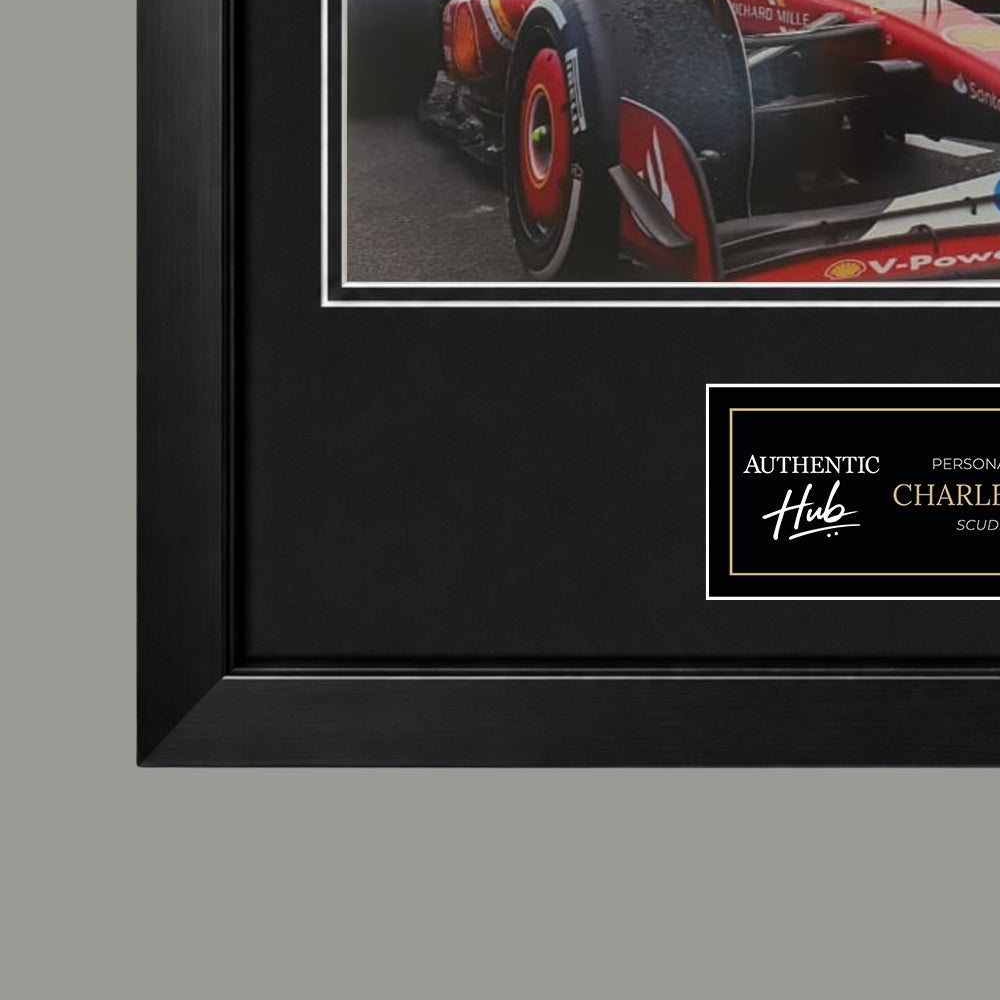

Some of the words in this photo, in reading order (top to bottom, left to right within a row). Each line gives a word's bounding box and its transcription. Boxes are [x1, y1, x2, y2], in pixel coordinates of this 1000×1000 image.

[776, 9, 811, 26] MILLE
[743, 454, 880, 475] AUTHENTIC
[762, 480, 859, 540] Hub
